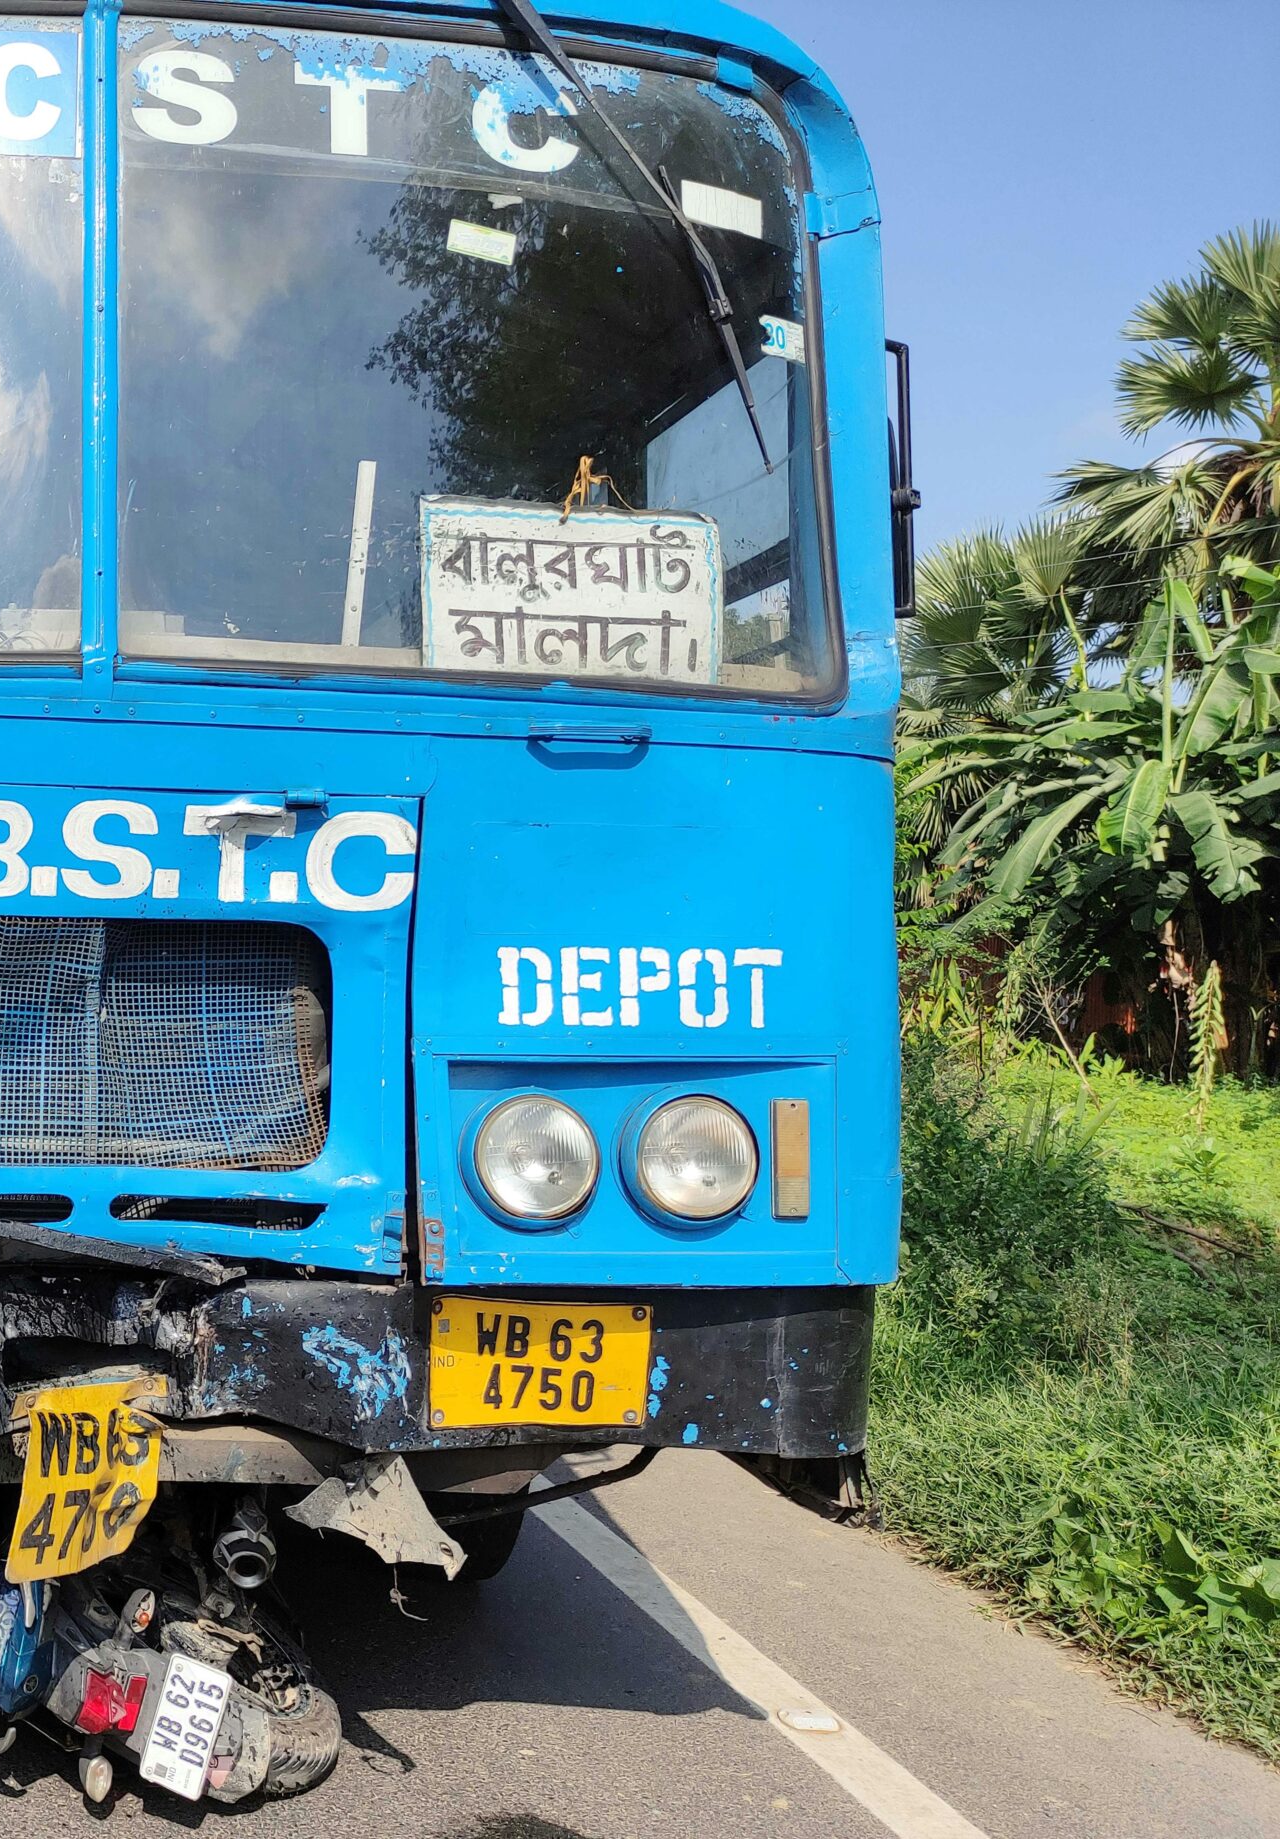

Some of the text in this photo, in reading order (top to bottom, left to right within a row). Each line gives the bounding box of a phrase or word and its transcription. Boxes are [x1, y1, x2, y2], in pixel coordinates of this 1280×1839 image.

[435, 525, 696, 602] বালুরঘাট
[496, 946, 784, 1029] DEPOT
[433, 1355, 455, 1368] IND
[476, 1312, 604, 1363] WB 63
[483, 1363, 595, 1412] 4750
[152, 1674, 196, 1752] WB 62
[178, 1681, 224, 1768] D9615
